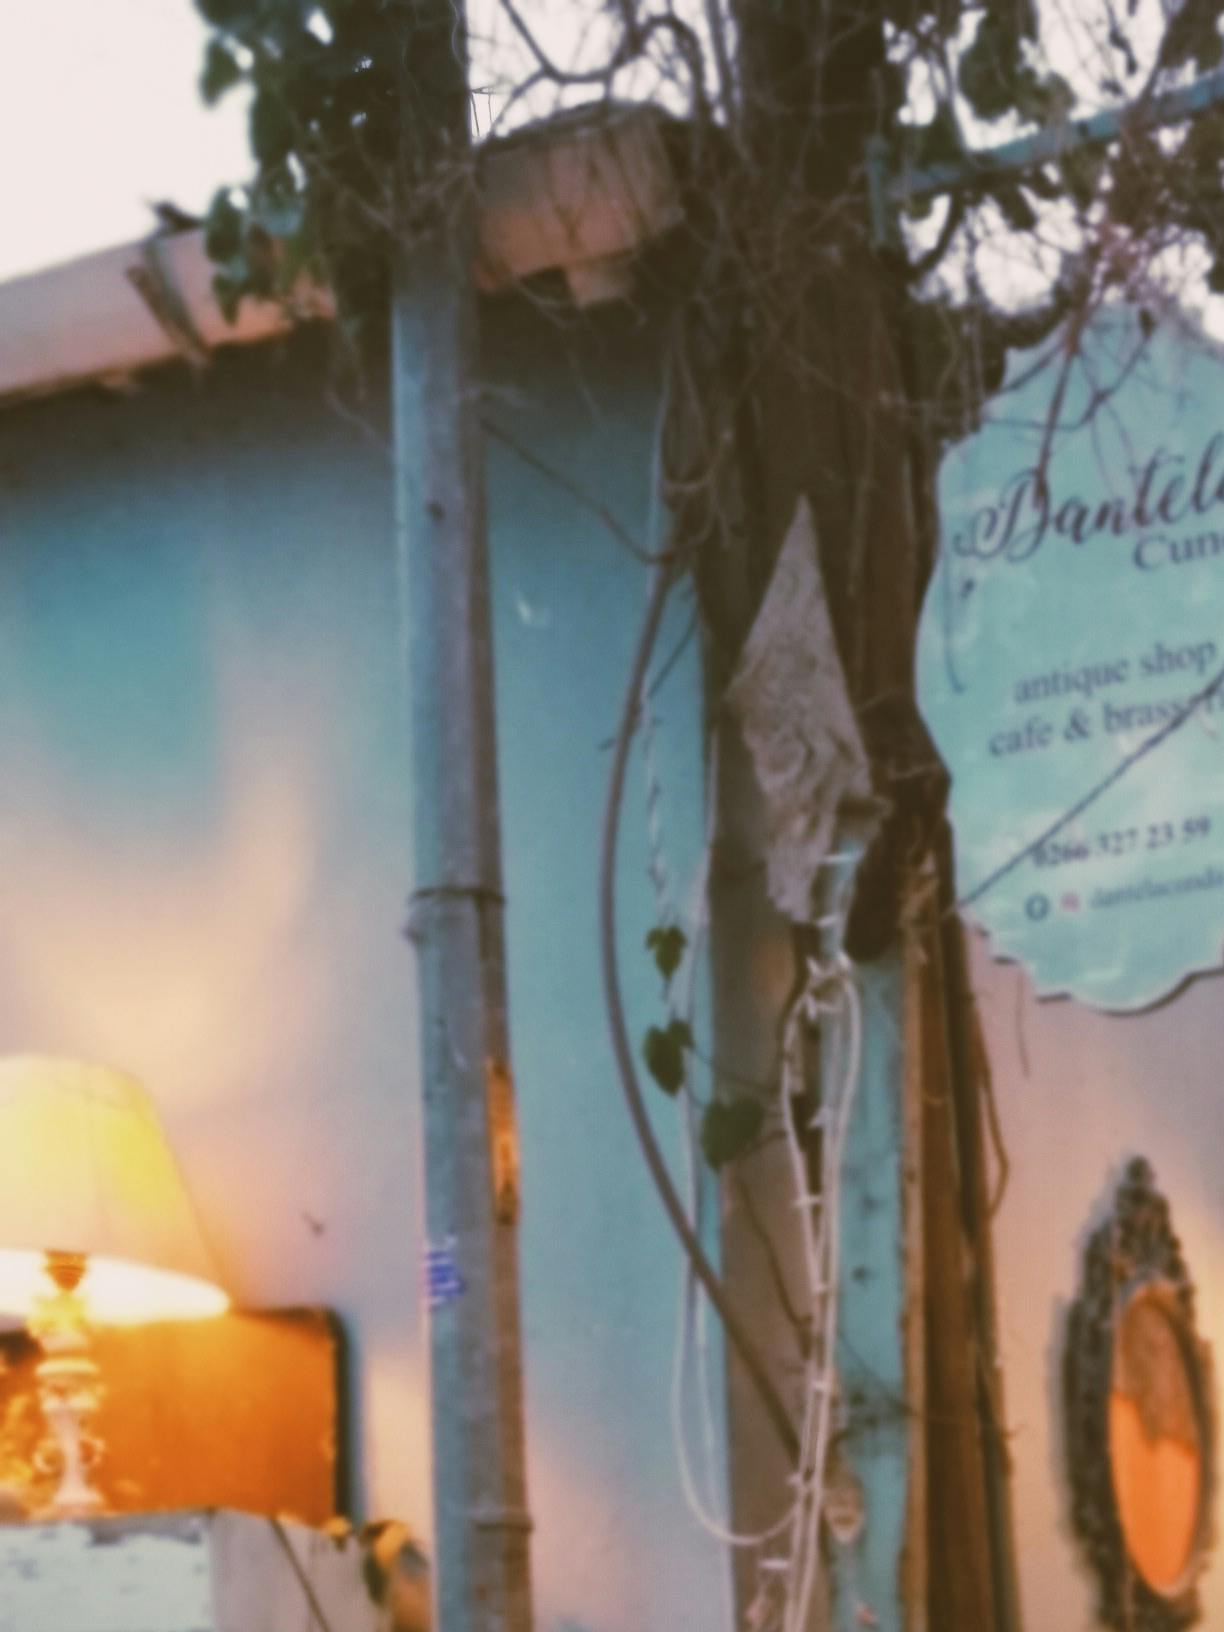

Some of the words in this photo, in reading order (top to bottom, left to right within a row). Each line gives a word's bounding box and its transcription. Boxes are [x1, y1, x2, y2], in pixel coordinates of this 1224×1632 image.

[1013, 658, 1130, 705] antique
[1139, 641, 1216, 676] shop
[989, 715, 1054, 758] cafe
[1063, 705, 1092, 741] &
